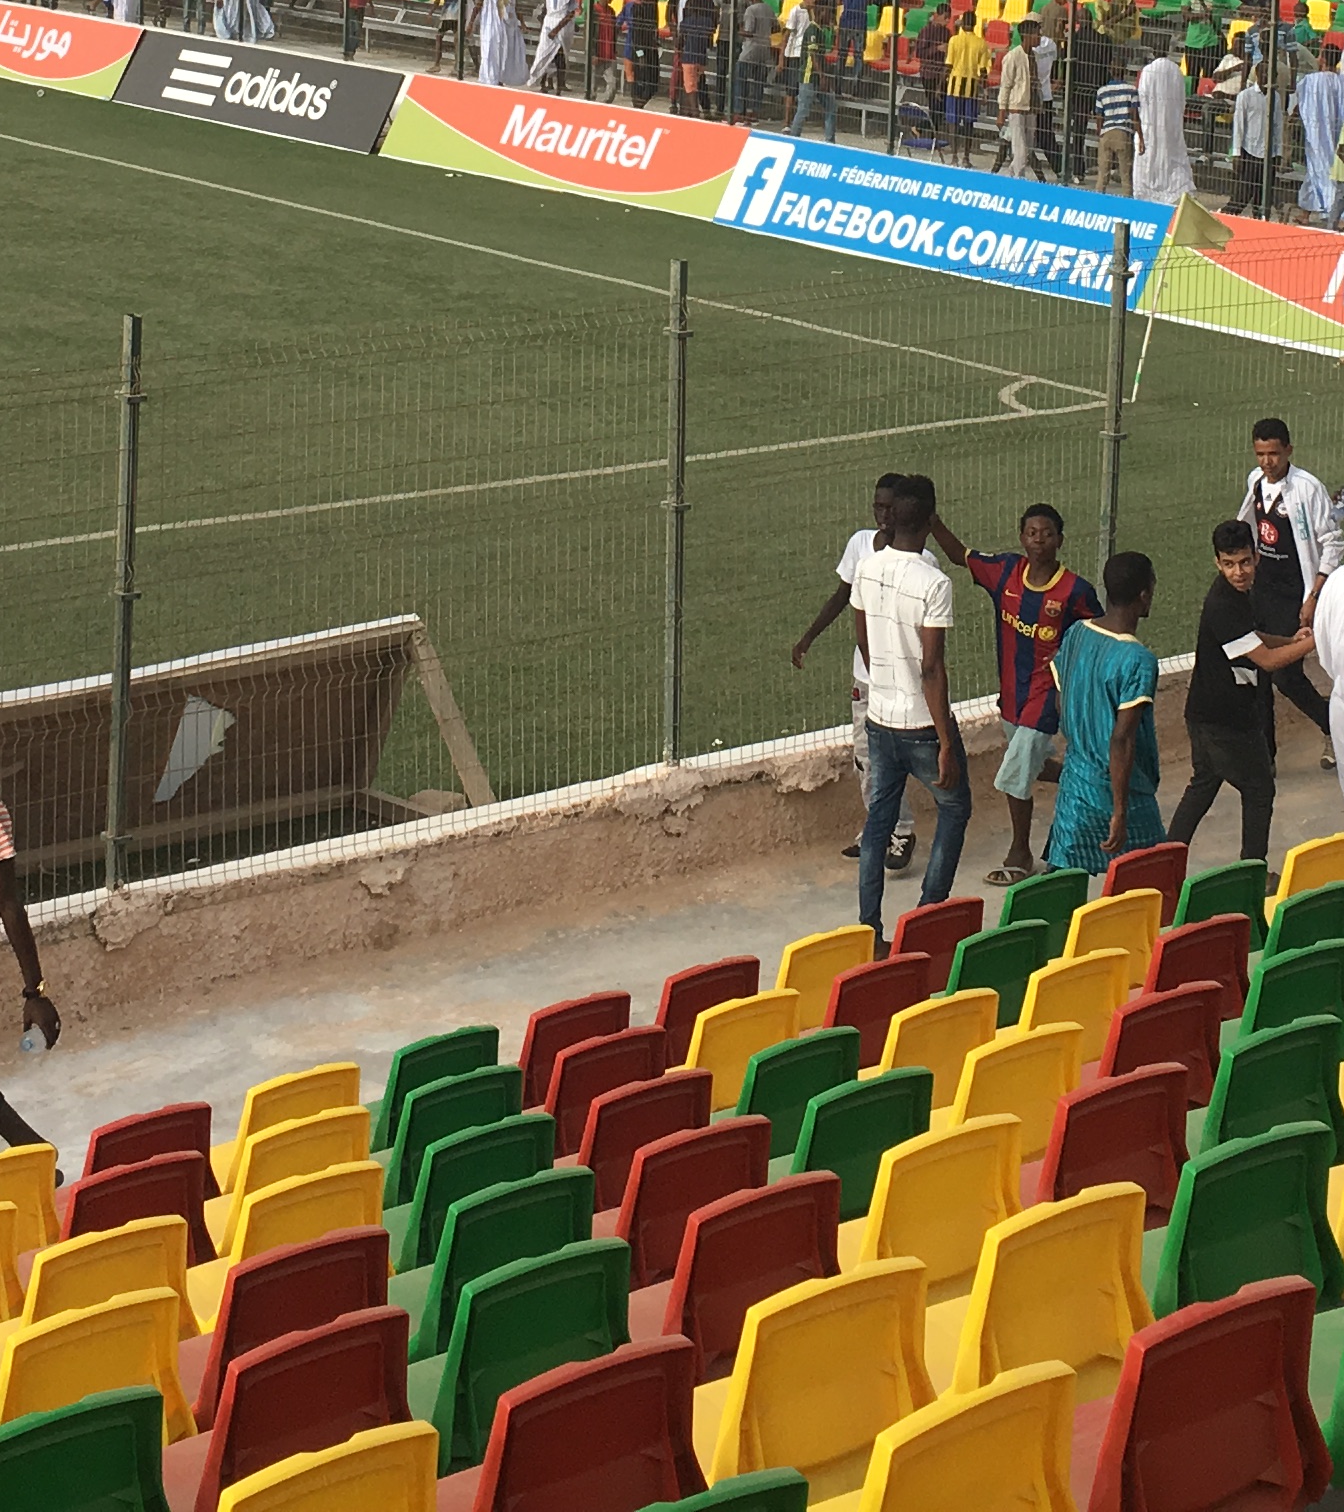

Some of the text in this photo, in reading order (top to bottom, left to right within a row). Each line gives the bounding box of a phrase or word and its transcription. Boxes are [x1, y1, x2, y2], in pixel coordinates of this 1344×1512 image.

[224, 67, 333, 121] adidas
[499, 104, 664, 170] Mauritel
[792, 158, 833, 180] FFRIM
[838, 165, 923, 197] FÉDÉRATION
[921, 181, 944, 201] DE
[942, 186, 1014, 215] FOOTBALL
[1016, 199, 1040, 219] DE
[1039, 204, 1060, 223] LA
[1061, 208, 1158, 241] MAURITNIE
[1001, 609, 1038, 638] unicef
